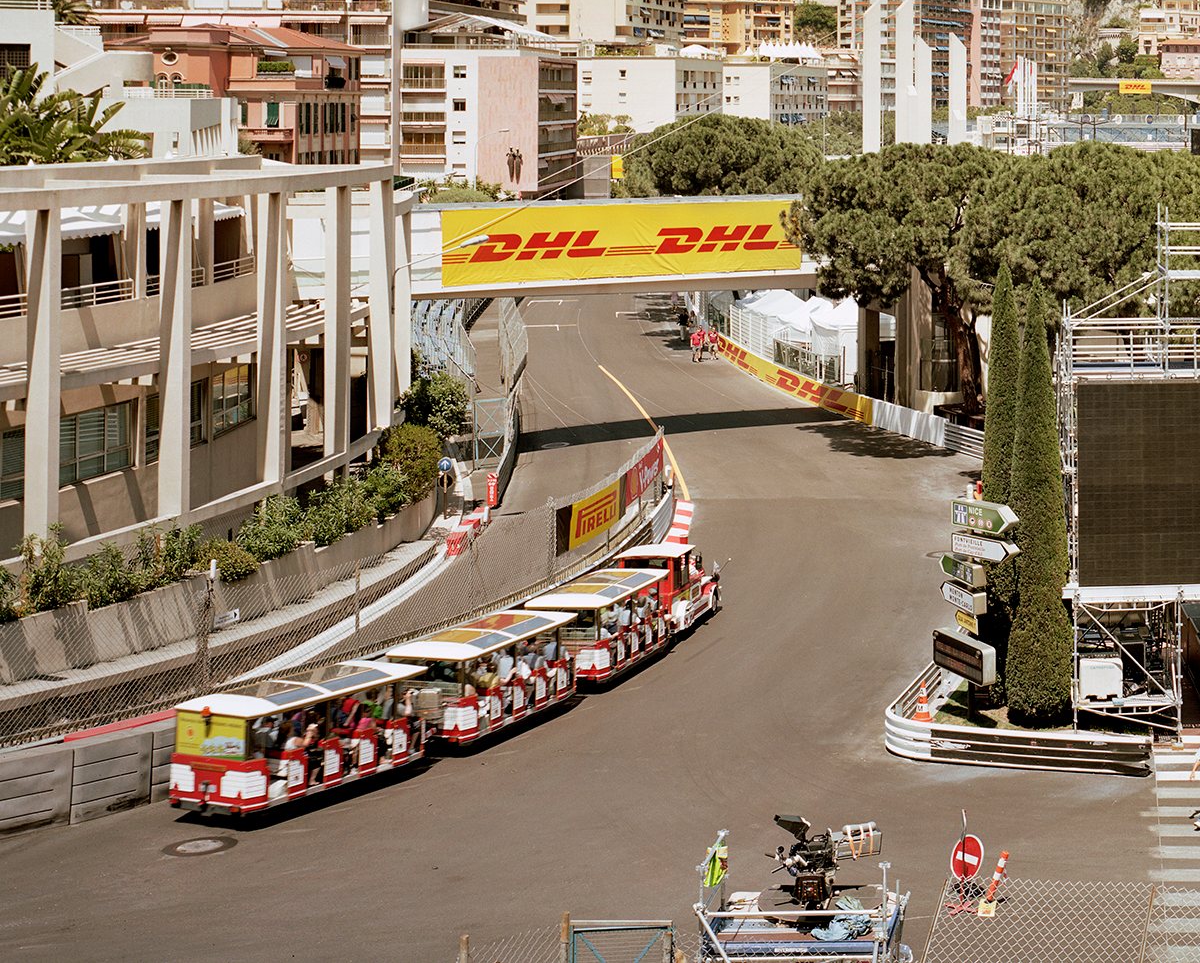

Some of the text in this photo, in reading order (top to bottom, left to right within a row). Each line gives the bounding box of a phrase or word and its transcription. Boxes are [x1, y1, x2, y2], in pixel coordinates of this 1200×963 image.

[468, 224, 779, 263] DHL DHL
[718, 338, 750, 370] DHL
[775, 369, 848, 413] DHL
[575, 489, 617, 539] PIRELLI
[968, 506, 983, 517] NICE
